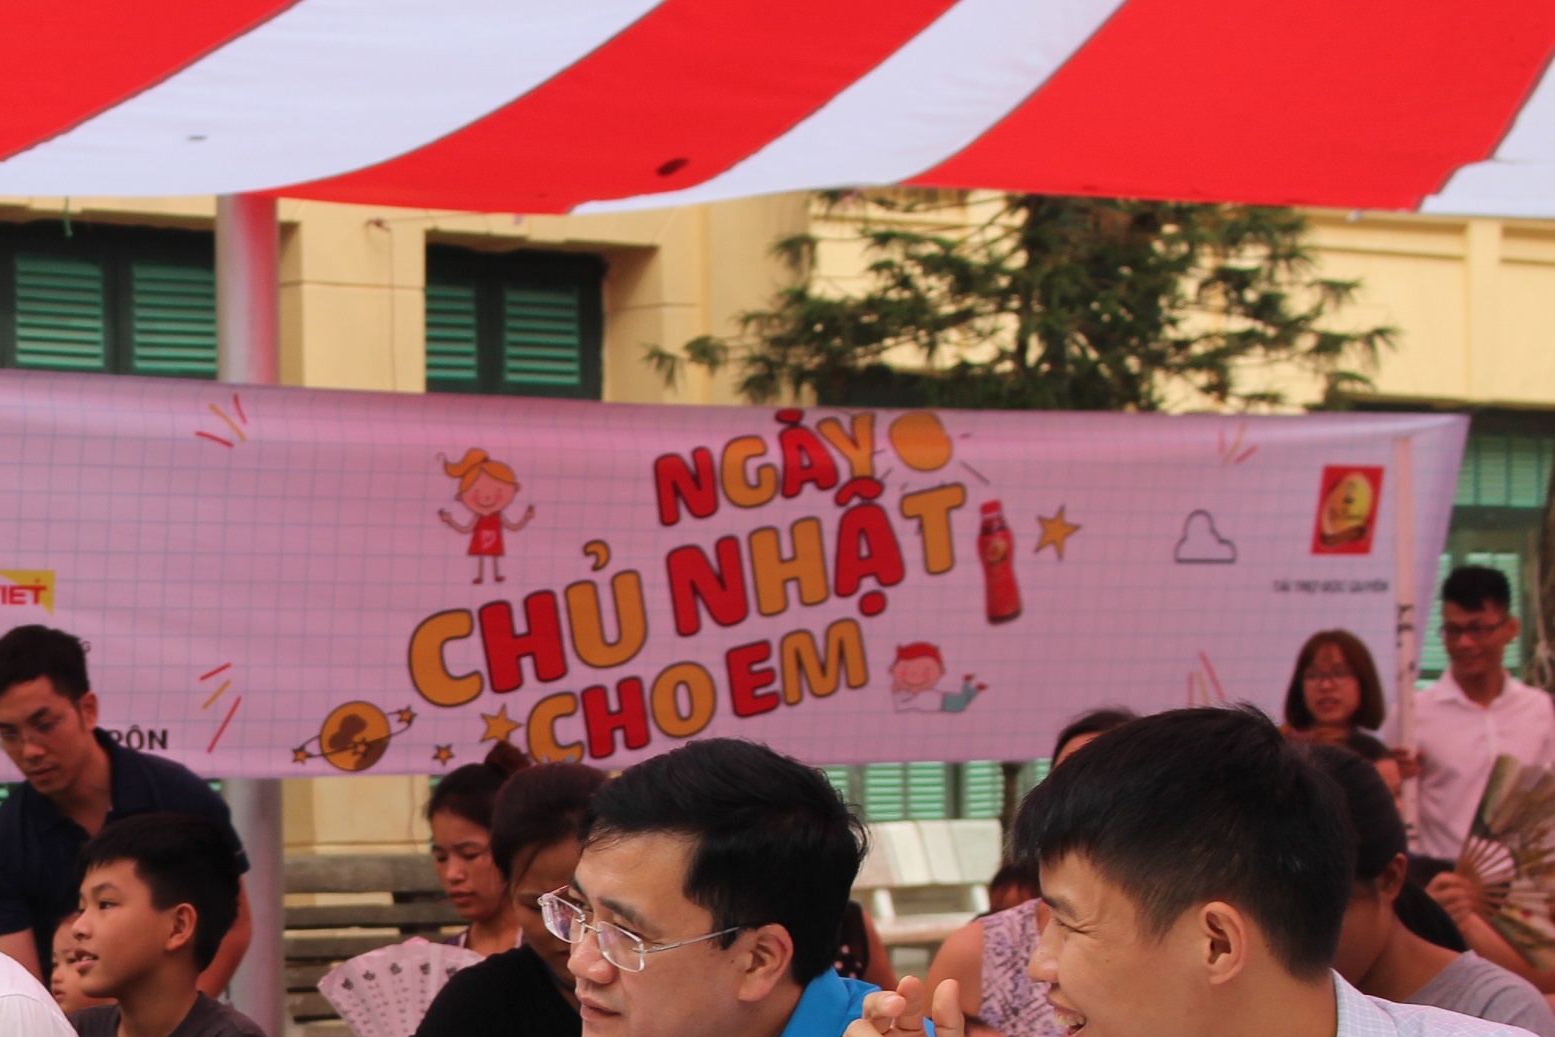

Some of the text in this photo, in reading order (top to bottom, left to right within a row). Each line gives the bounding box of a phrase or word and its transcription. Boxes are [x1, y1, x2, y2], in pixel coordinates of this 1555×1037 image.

[654, 408, 875, 525] NGÀY
[408, 477, 966, 706] CHỦ NHẬT
[527, 617, 868, 762] CHO EM
